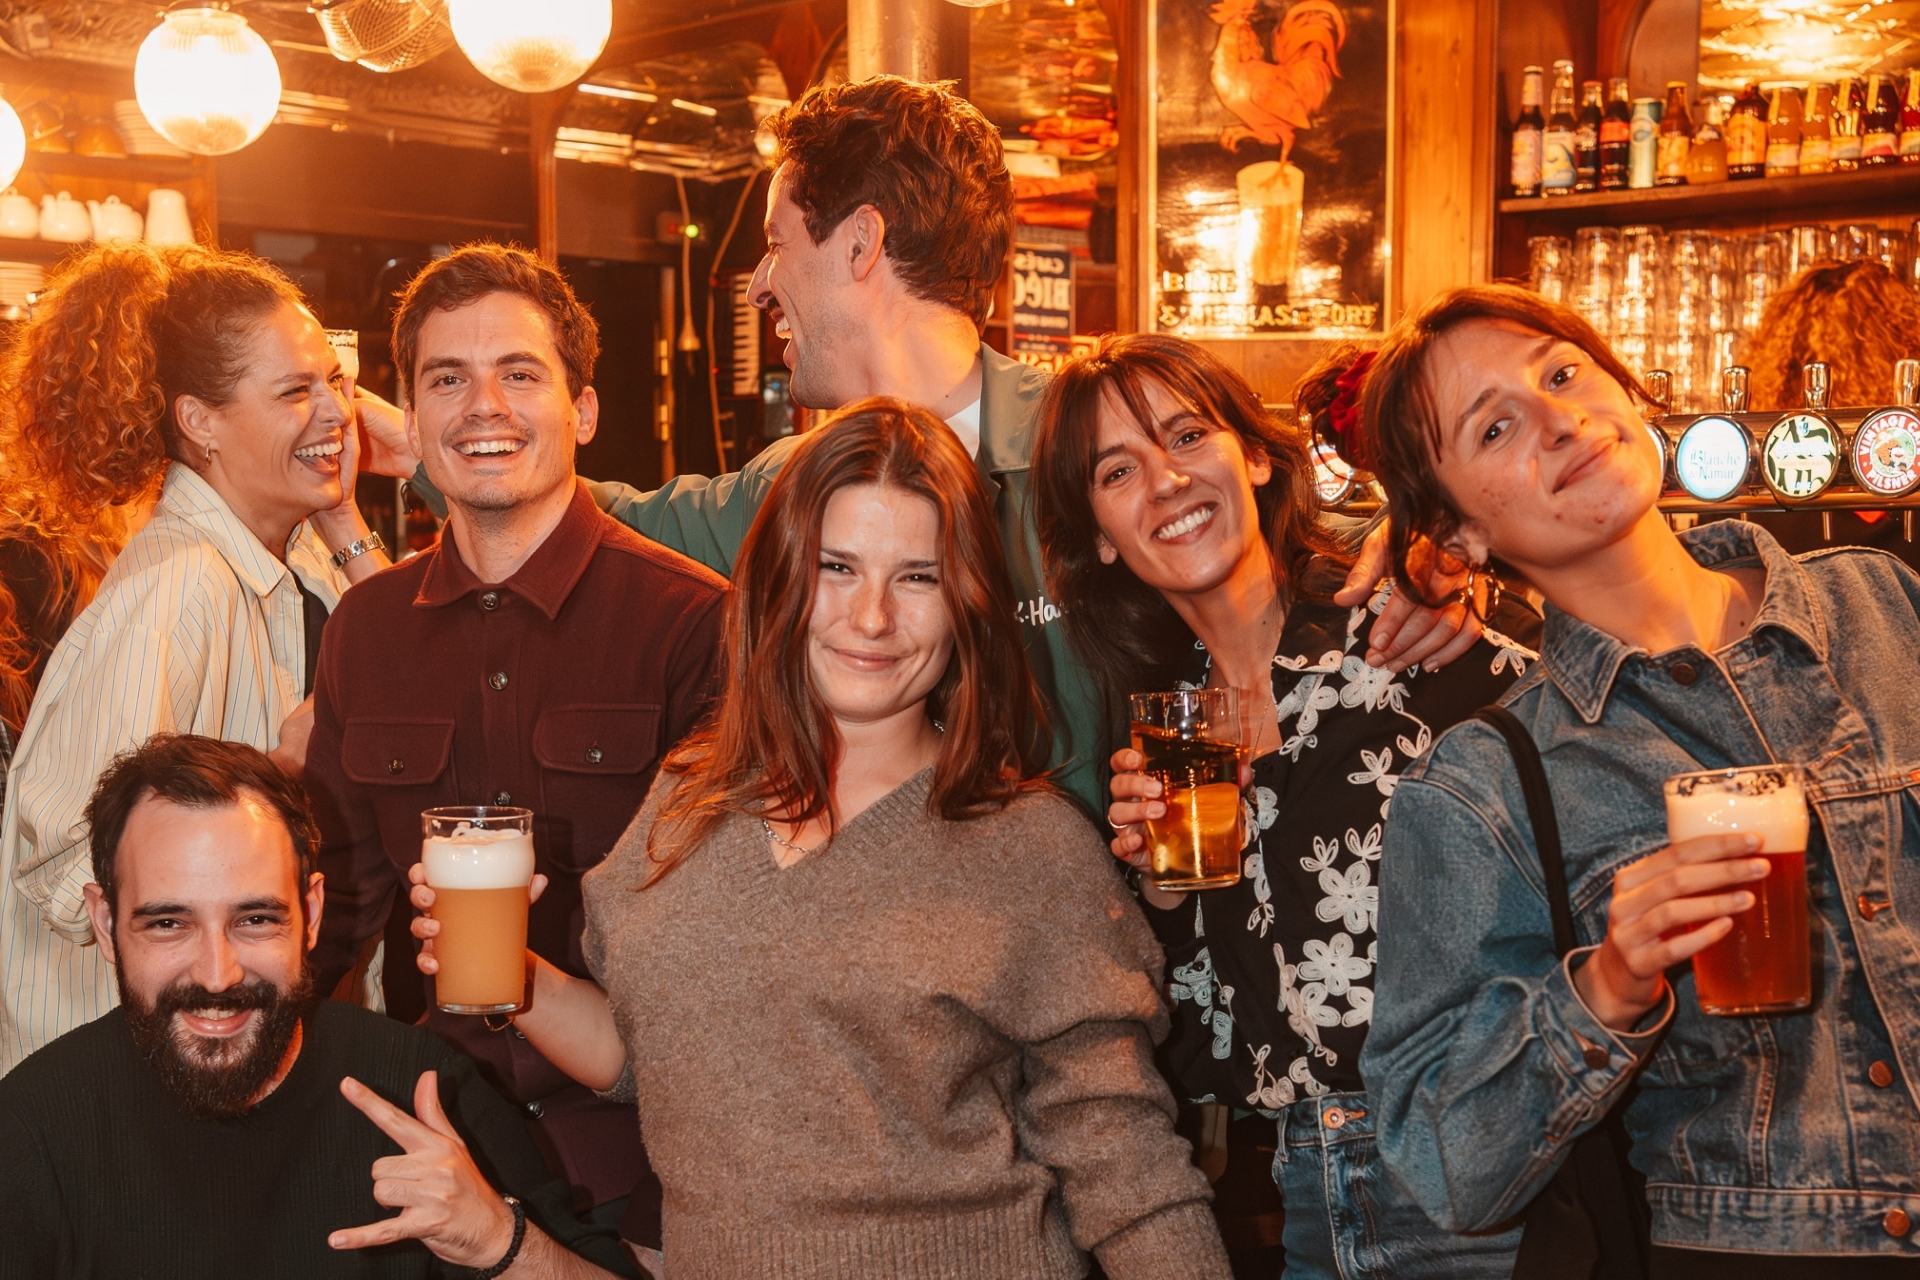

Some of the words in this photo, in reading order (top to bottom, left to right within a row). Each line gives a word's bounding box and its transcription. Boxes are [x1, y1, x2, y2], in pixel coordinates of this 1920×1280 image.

[1859, 414, 1907, 455] VINTAGE
[1689, 448, 1740, 465] Blanche
[1699, 465, 1736, 480] Namur
[1866, 469, 1918, 489] PILSNER
